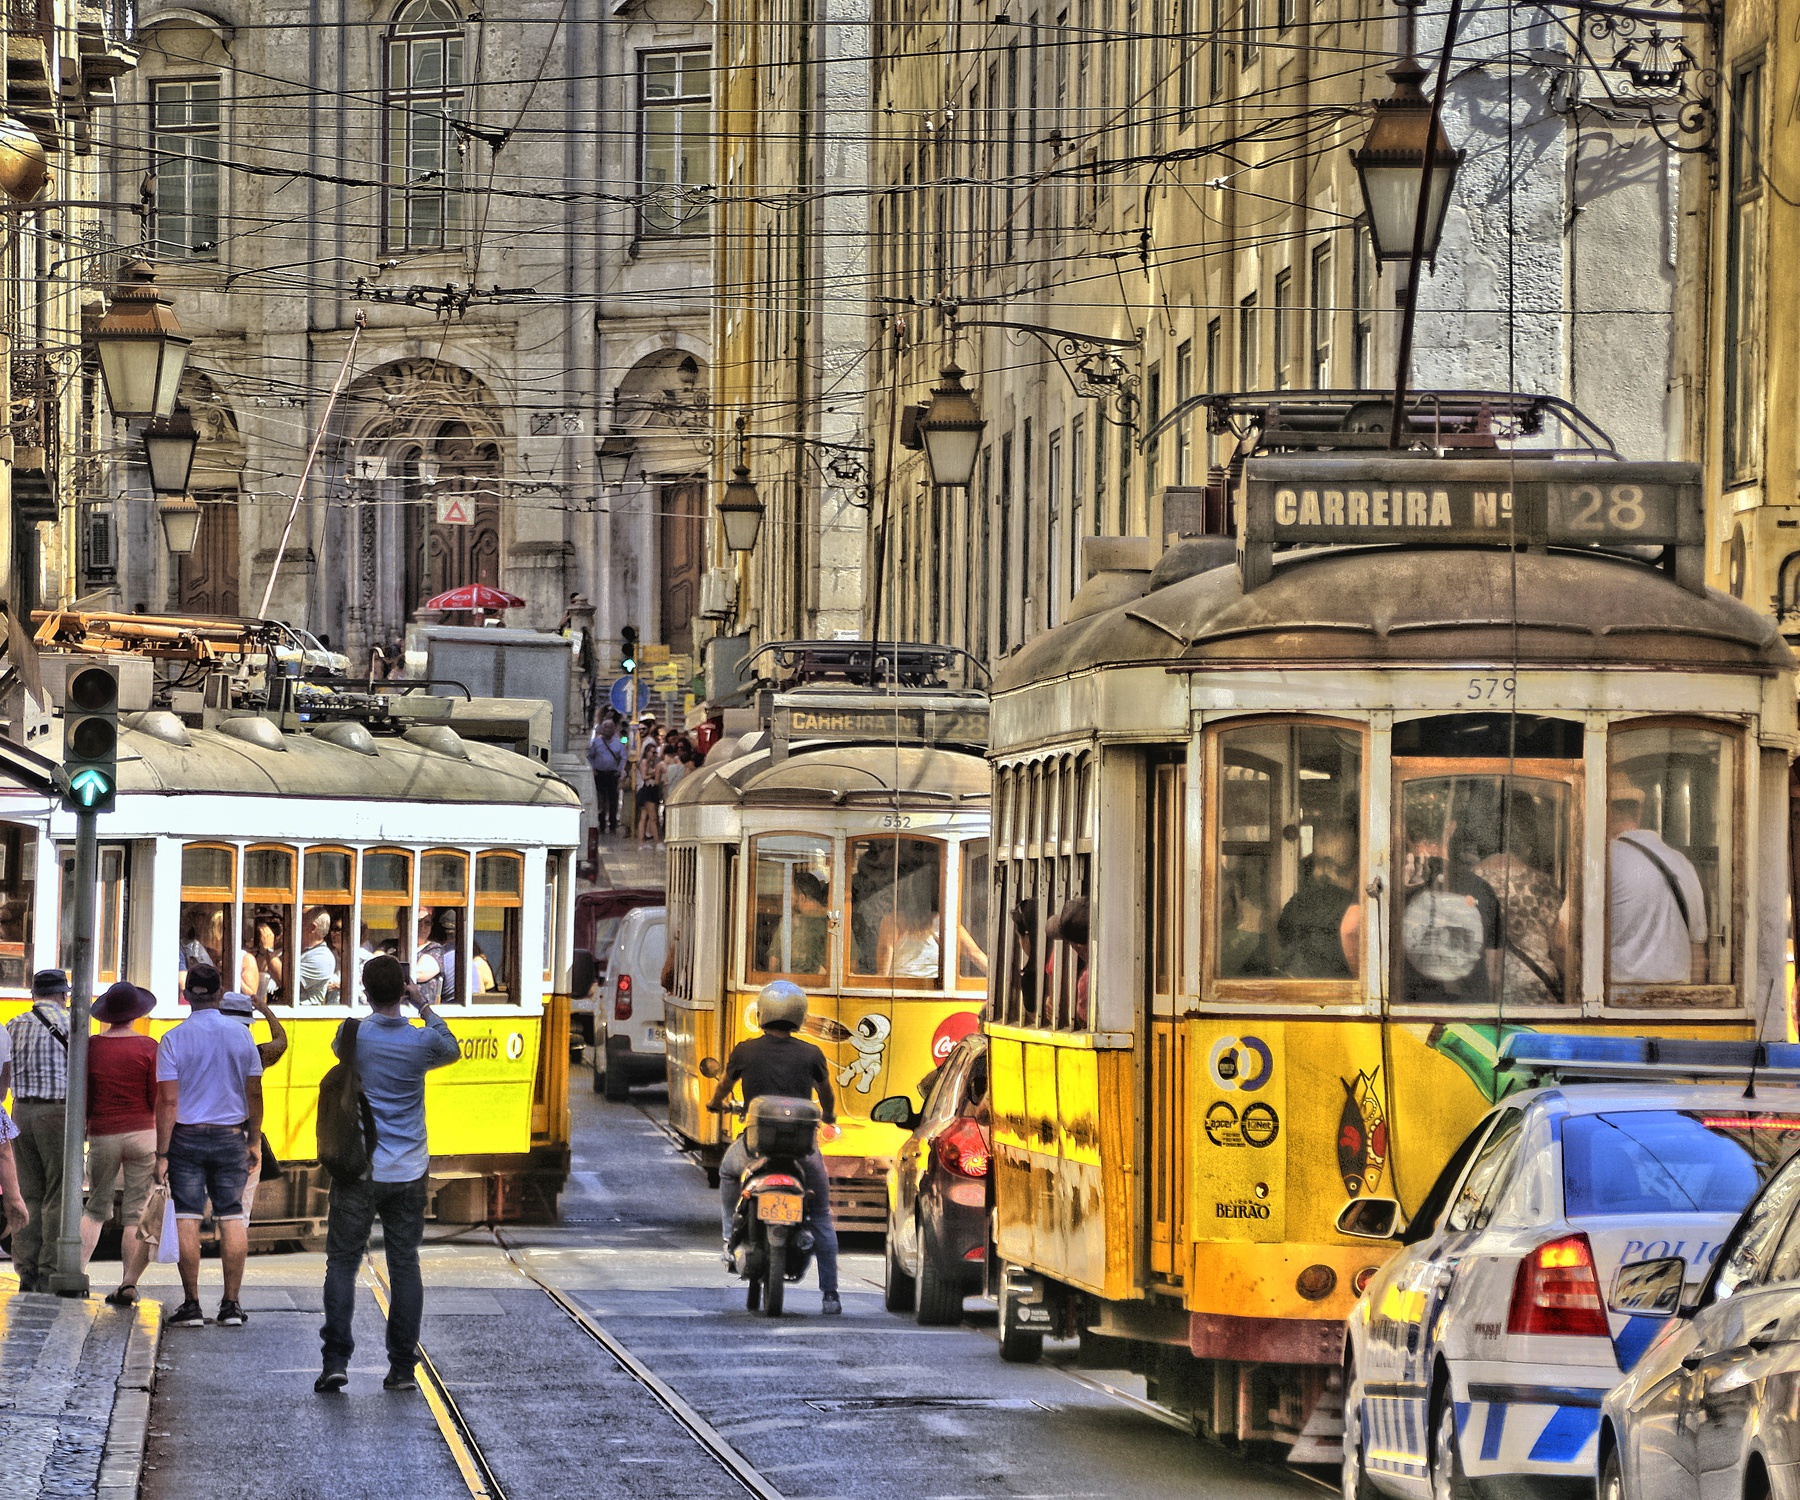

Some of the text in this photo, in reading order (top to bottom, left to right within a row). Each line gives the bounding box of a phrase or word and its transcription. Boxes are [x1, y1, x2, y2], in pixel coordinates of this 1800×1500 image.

[1275, 490, 1452, 527] CARREIRA
[1569, 484, 1646, 532] 28
[1467, 677, 1517, 700] 579
[792, 712, 887, 731] CARREIRA
[951, 713, 987, 740] 28
[883, 815, 911, 829] 552
[1215, 1202, 1271, 1220] BEIRÃO
